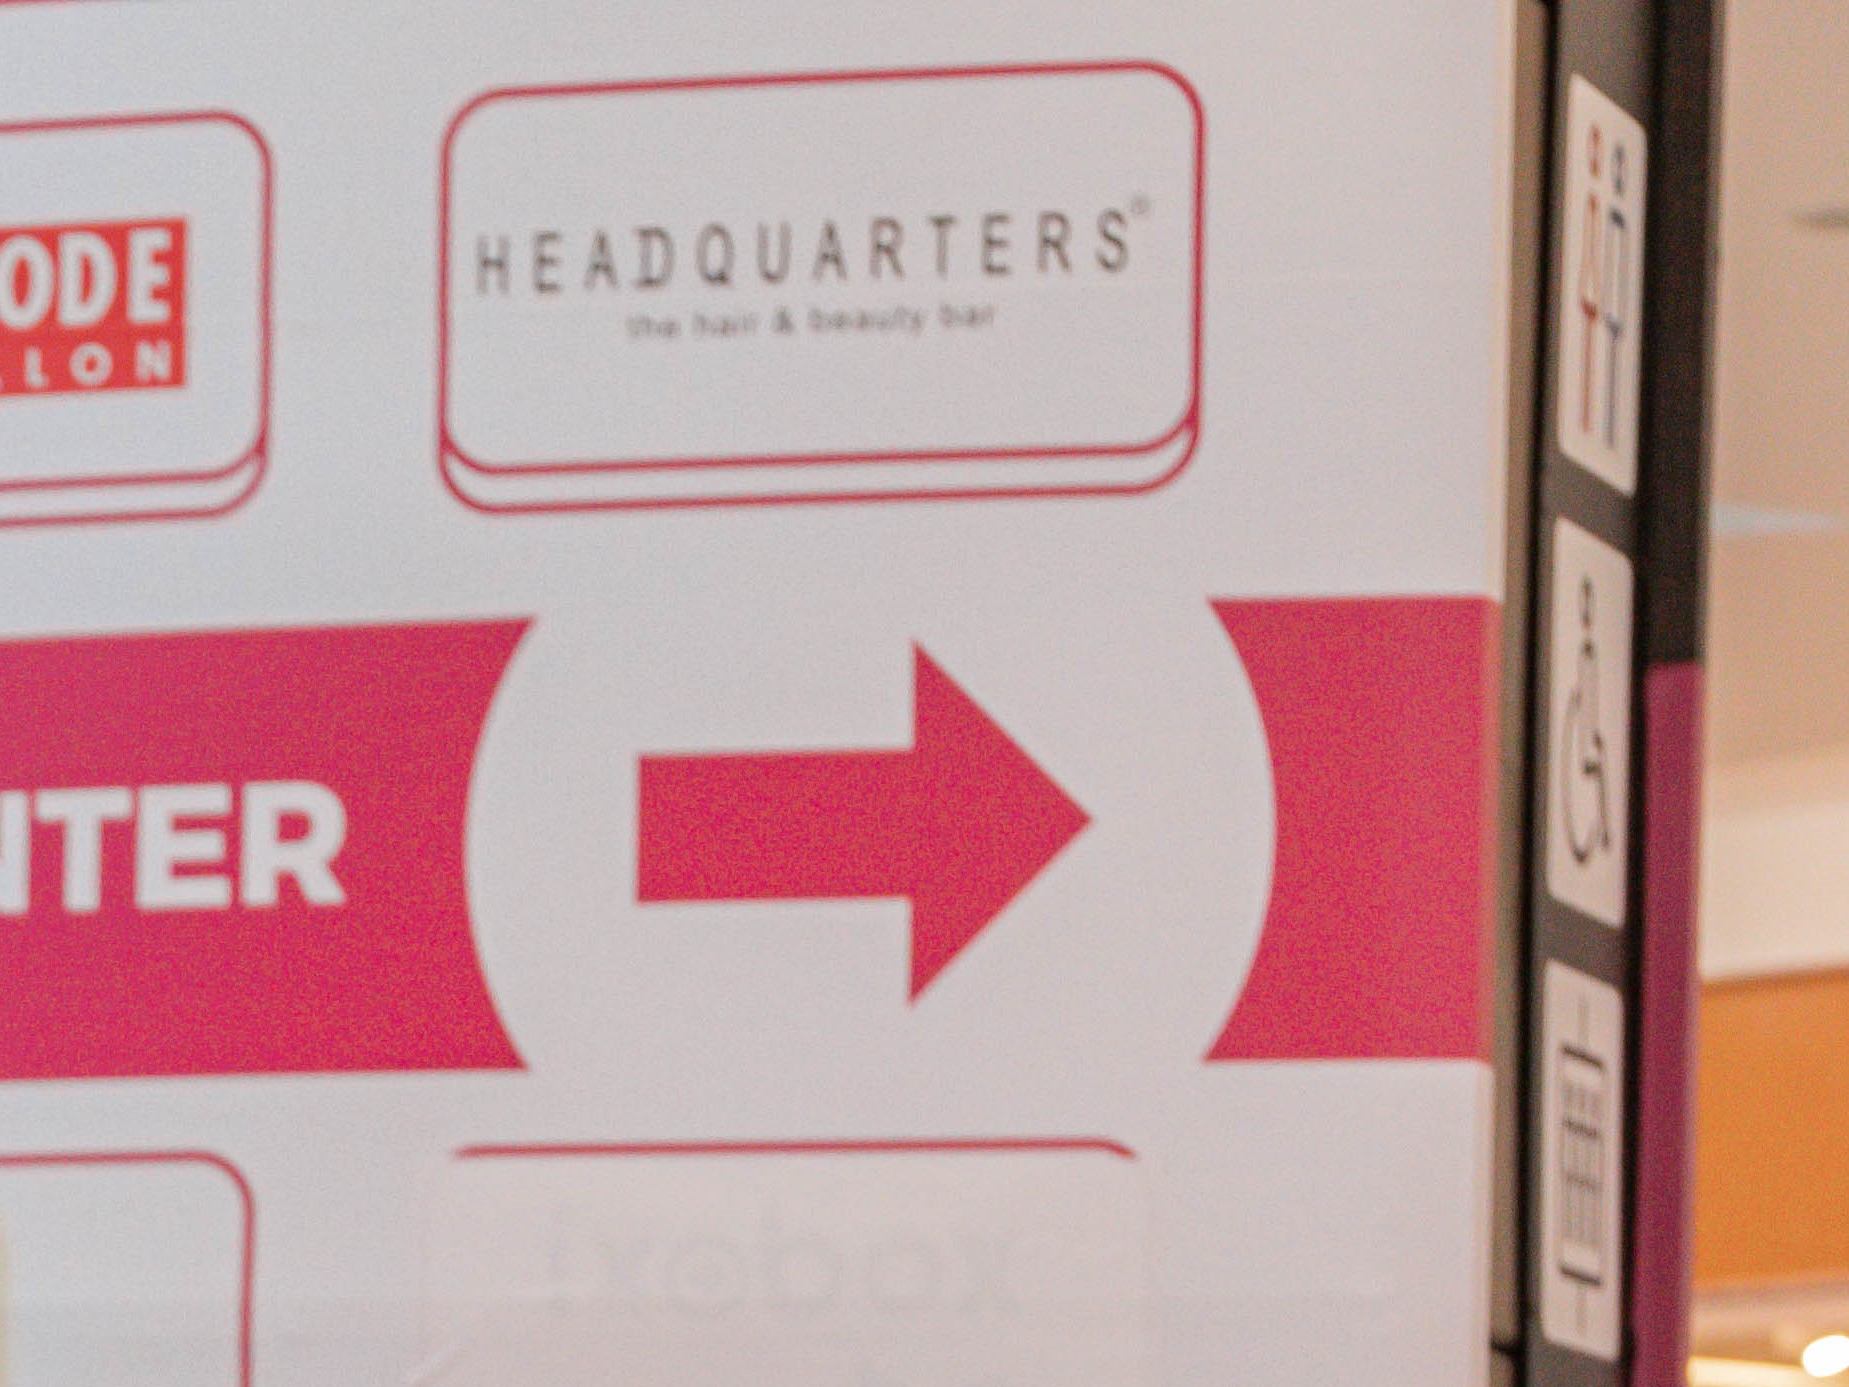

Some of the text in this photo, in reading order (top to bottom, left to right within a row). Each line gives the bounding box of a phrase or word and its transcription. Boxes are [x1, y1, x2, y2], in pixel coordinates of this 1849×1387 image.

[628, 300, 995, 339] the hair & beauty bar
